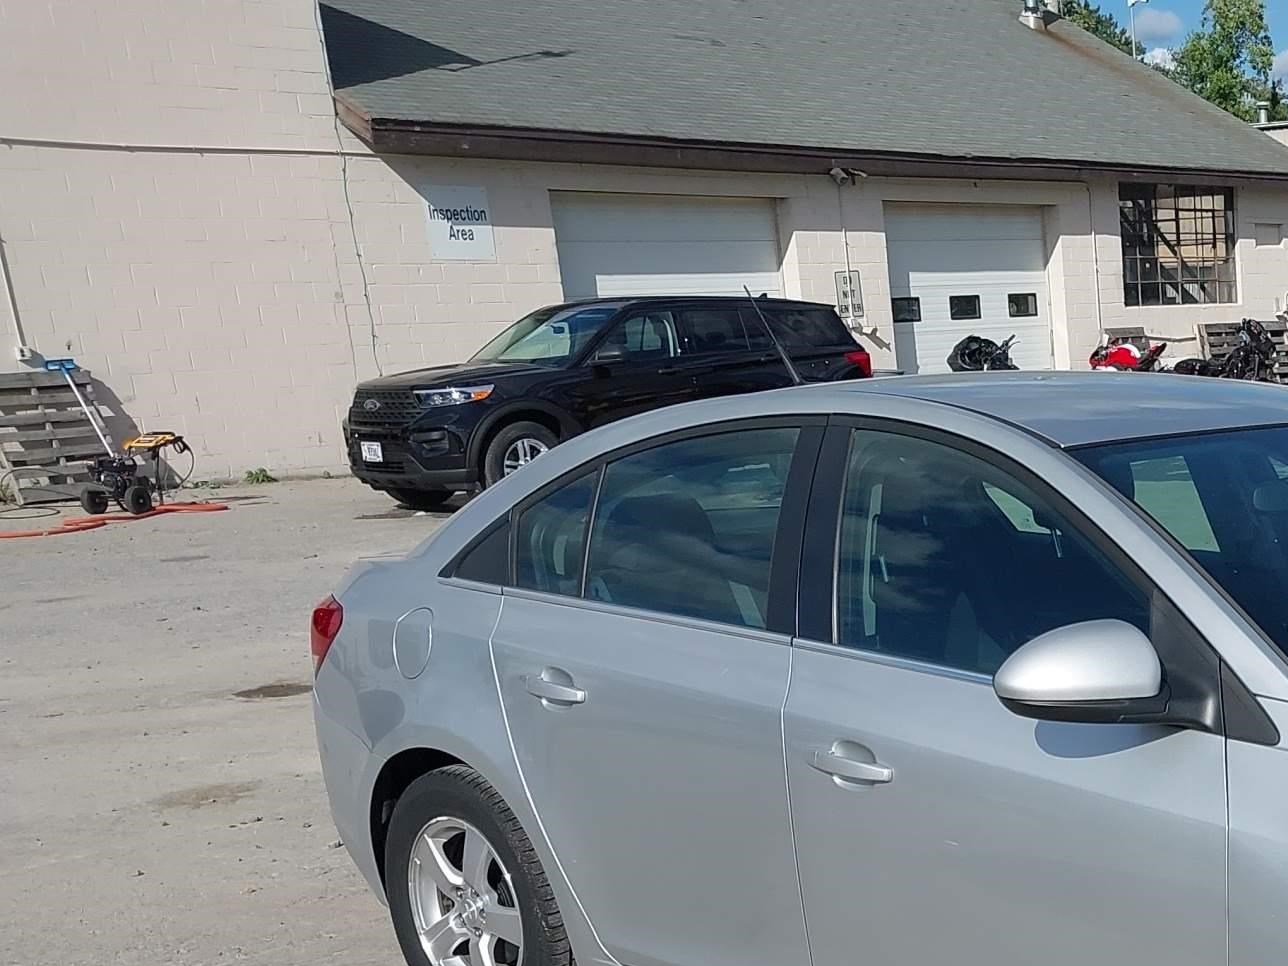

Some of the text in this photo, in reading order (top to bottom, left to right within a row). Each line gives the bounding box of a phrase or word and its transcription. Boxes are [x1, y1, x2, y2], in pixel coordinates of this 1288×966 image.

[428, 204, 487, 223] Inspection
[449, 225, 475, 241] Area
[842, 289, 855, 299] NT
[840, 303, 862, 313] ENER
